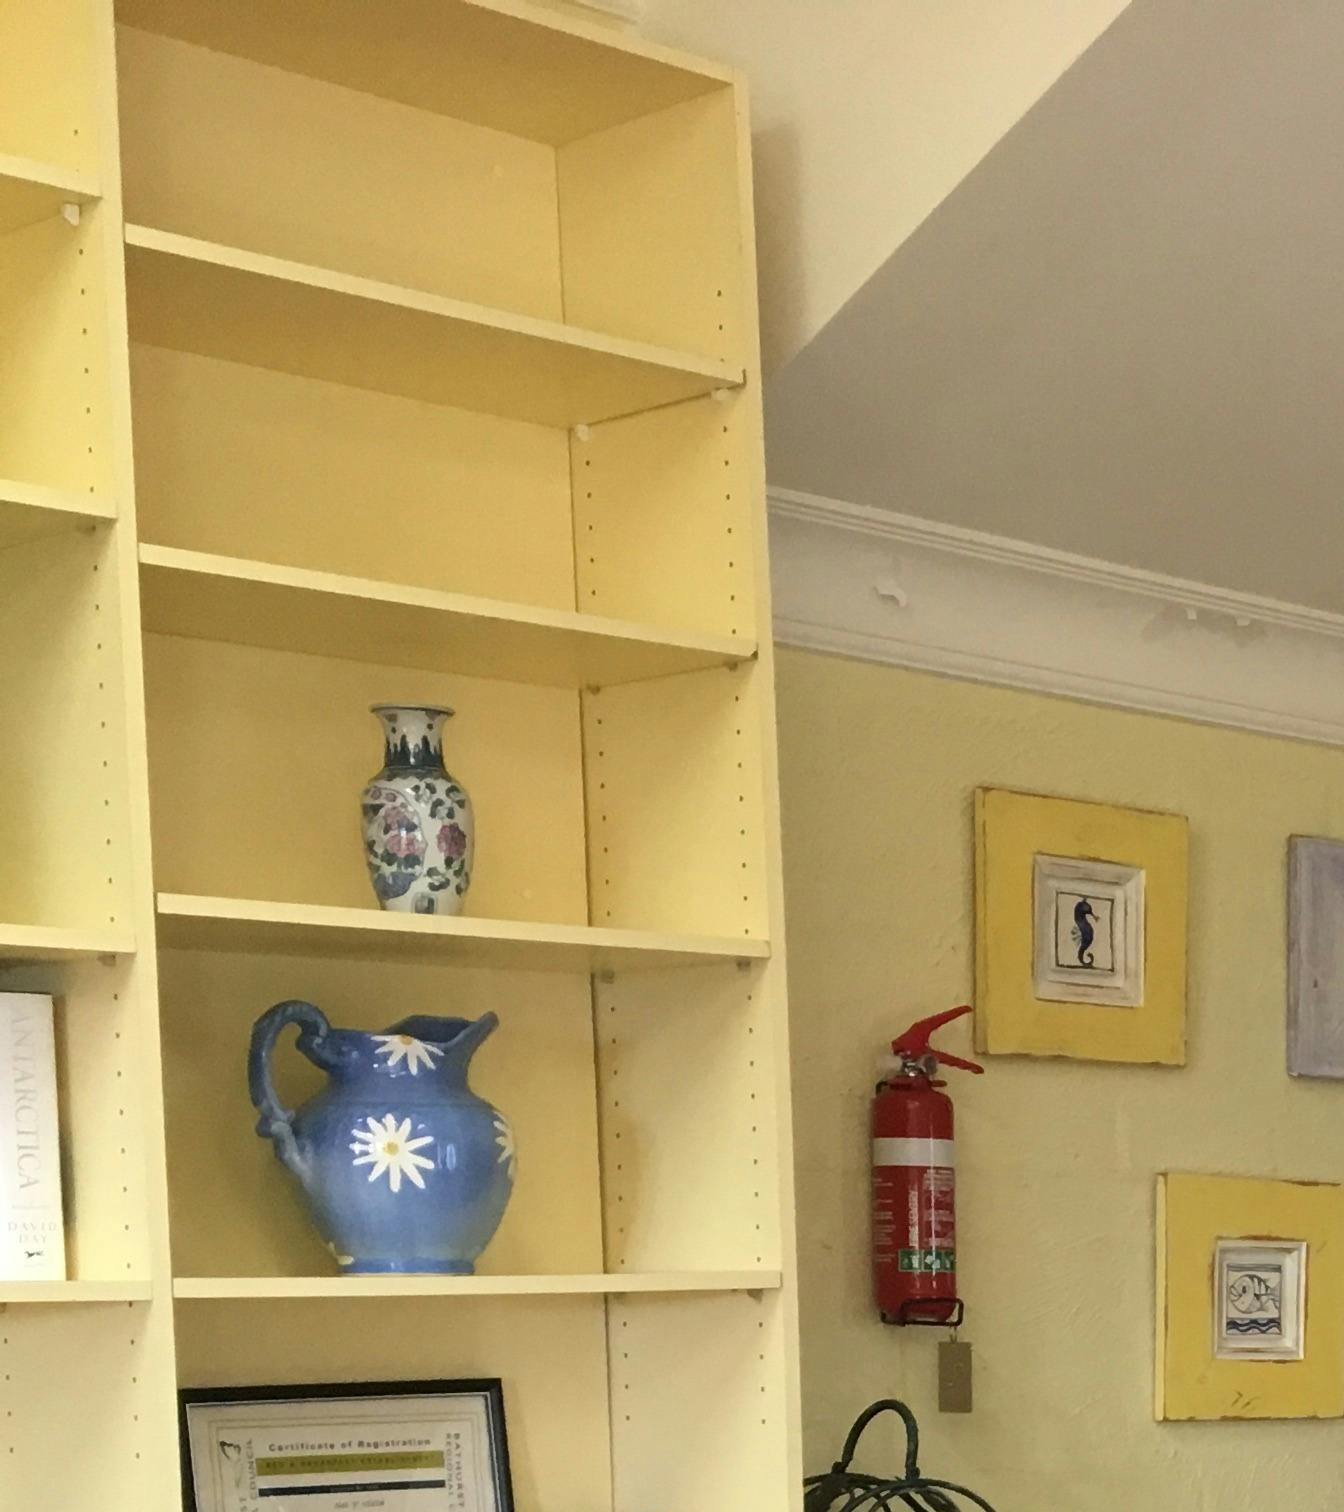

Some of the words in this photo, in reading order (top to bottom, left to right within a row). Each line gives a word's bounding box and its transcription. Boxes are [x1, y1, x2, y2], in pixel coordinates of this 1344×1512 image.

[10, 1007, 42, 1191] ANTARCTICA
[267, 1441, 336, 1452] Certificate
[340, 1440, 354, 1450] of
[357, 1437, 433, 1450] Registration
